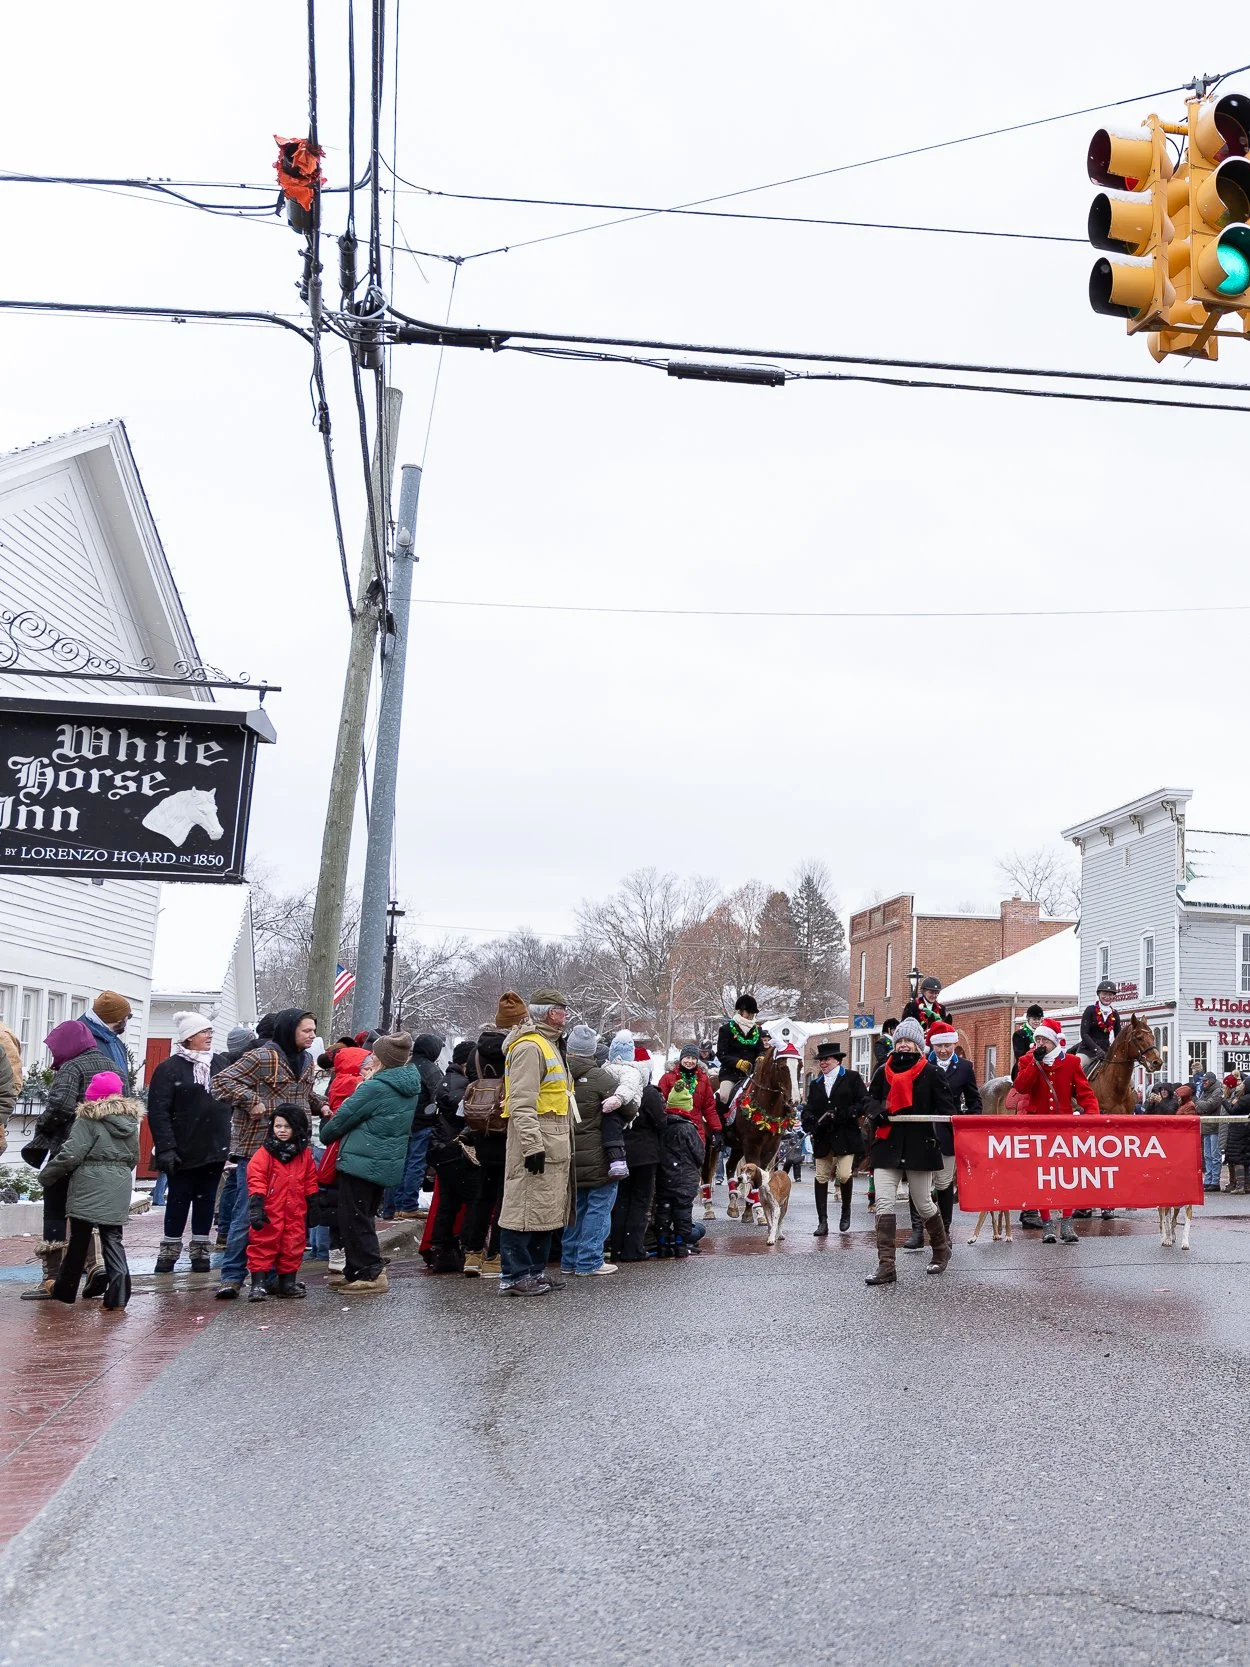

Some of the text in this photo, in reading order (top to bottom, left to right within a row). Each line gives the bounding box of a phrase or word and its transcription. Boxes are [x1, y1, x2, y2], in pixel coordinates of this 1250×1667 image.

[52, 724, 229, 766] White
[8, 755, 170, 802] Horse
[5, 848, 17, 856] BY
[21, 847, 108, 862] LORENZO
[113, 851, 176, 864] HOARD
[193, 854, 224, 866] 1850
[1208, 1016, 1217, 1027] &
[988, 1134, 1167, 1159] METAMORA
[1037, 1166, 1119, 1190] HUNT
